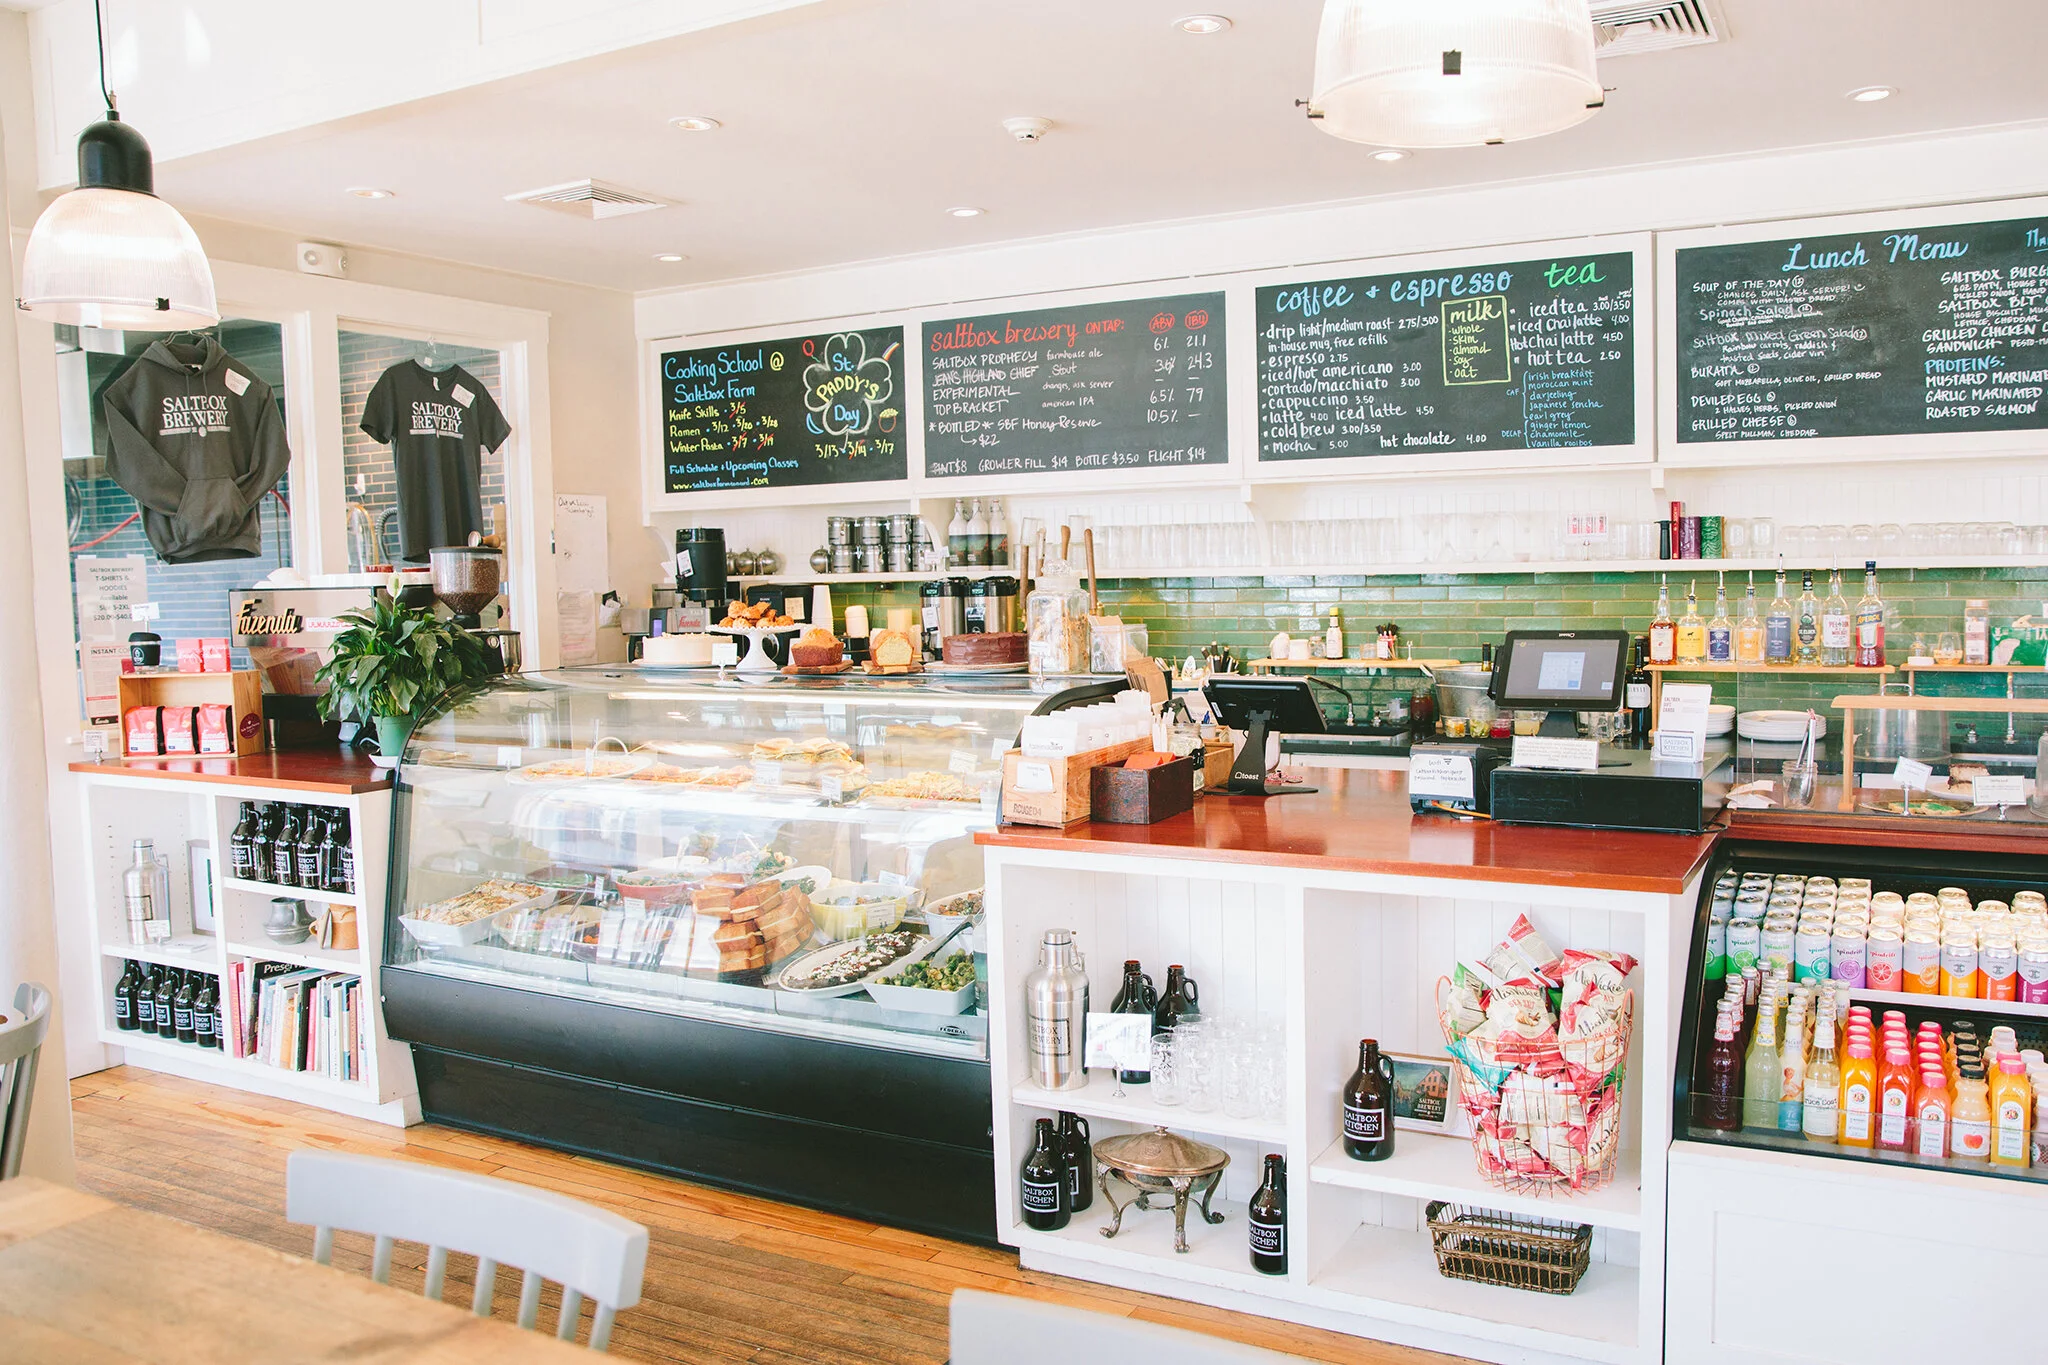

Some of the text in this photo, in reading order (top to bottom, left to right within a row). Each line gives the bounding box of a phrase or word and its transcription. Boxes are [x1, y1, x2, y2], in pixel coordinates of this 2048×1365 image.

[1782, 231, 1968, 273] Lunch Menu
[1544, 261, 1607, 289] tea
[1940, 269, 2003, 286] SALTBOX
[1692, 277, 1790, 293] SOUP OF THE DAY
[1275, 270, 1513, 318] coffee espresso
[1450, 300, 1502, 324] milk
[1530, 297, 1588, 318] iced tea
[1699, 306, 1752, 321] Spinach
[1755, 304, 1794, 317] Salad
[1938, 295, 2042, 314] SALTBOX BLT
[1266, 317, 1395, 343] drip light/medium roast
[1451, 324, 1485, 334] whole
[1517, 314, 1603, 334] iced latte
[931, 320, 1102, 352] saltbox brewery ON
[1333, 333, 1388, 348] free refills
[1510, 332, 1595, 351] Hot latte
[1788, 329, 1827, 342] Green
[1922, 324, 2036, 343] GRILLED CHICKEN
[1452, 343, 1492, 355] almond
[1926, 338, 2003, 354] SANDWICH
[834, 353, 854, 371] St.
[932, 347, 1103, 369] SALTBOX PROPHECY ale
[1010, 353, 1213, 379] CHIEF Stout 24.3
[1268, 353, 1324, 368] espresso
[1453, 356, 1474, 368] soy
[1527, 350, 1621, 367] hot tea 2.50
[1924, 355, 2006, 374] PROTEINS:
[664, 349, 784, 387] Cooking School @
[1267, 362, 1393, 383] iced/hot americano
[1454, 367, 1478, 378] oat
[1528, 367, 1595, 381] irish breakfast
[816, 375, 880, 402] PADDY'S
[1267, 377, 1388, 396] cortado/macchiato
[1528, 381, 1570, 390] moroccan
[1925, 373, 1988, 388] MUSTARD
[674, 378, 755, 404] Saltbox Farm
[933, 380, 1114, 401] EXPERIMENTAL server
[1079, 387, 1204, 406] IPA 79
[1529, 390, 1577, 402] darjeeling
[1925, 387, 2043, 404] GARLIC MARINATED
[162, 395, 227, 413] SALTBOX
[1268, 394, 1349, 410] cappuccino
[1571, 399, 1604, 409] sencha
[1691, 393, 1761, 408] DEVILED EGG
[411, 401, 462, 420] SALTBOX
[668, 405, 720, 422] Knife Skills
[834, 405, 860, 429] Day
[1269, 403, 1407, 424] latte iced latte
[1926, 401, 2038, 420] ROASTED SALMON
[161, 410, 229, 429] BREWERY
[411, 415, 462, 433] BREWERY
[1022, 416, 1102, 433] Honey Reserve
[1530, 420, 1591, 432] ginger lemon
[1692, 415, 1786, 431] GRILLED CHEESE
[669, 421, 729, 437] Ramen 3/12
[1271, 423, 1335, 438] cold brew
[1530, 430, 1585, 438] chamomile
[670, 437, 724, 453] Winter Pasta
[875, 439, 895, 454] 3/17
[978, 434, 1001, 448] $22
[1273, 440, 1316, 454] mocha
[1380, 430, 1456, 448] hot chocolate
[669, 456, 799, 478] Full Schedule Upcoming Classes
[978, 447, 1206, 472] GROWLER FILL $14 BOTTLE FLIGHT $14
[236, 599, 305, 636] Fazenda
[939, 1027, 967, 1035] FEDERAL
[1418, 1098, 1441, 1106] SALTBOX
[1344, 1110, 1378, 1123] SALTBOX
[1344, 1118, 1379, 1131] KITCHEN
[1024, 1193, 1054, 1204] KITCHEN
